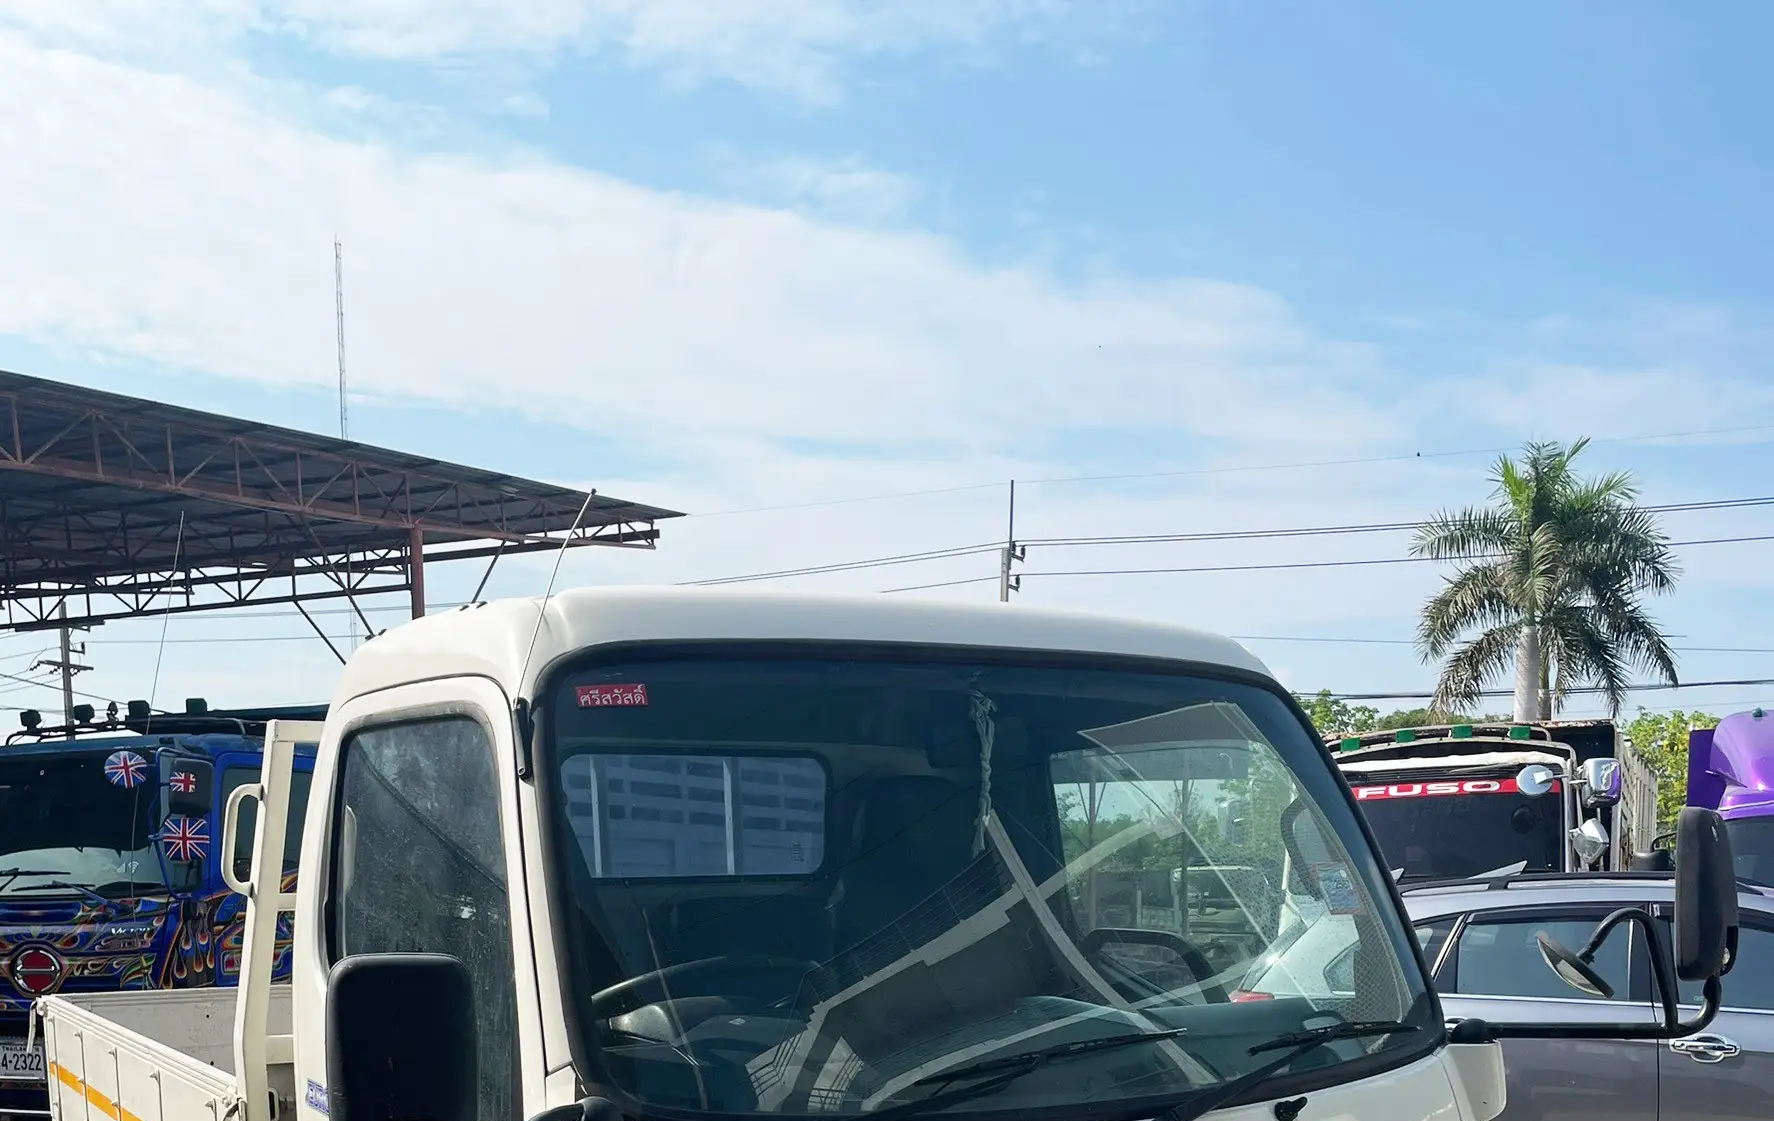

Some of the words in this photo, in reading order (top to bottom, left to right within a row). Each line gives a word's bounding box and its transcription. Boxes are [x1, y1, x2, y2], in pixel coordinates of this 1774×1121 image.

[579, 683, 647, 706] ศรีสวัสดิ์
[1357, 780, 1501, 800] FUSO
